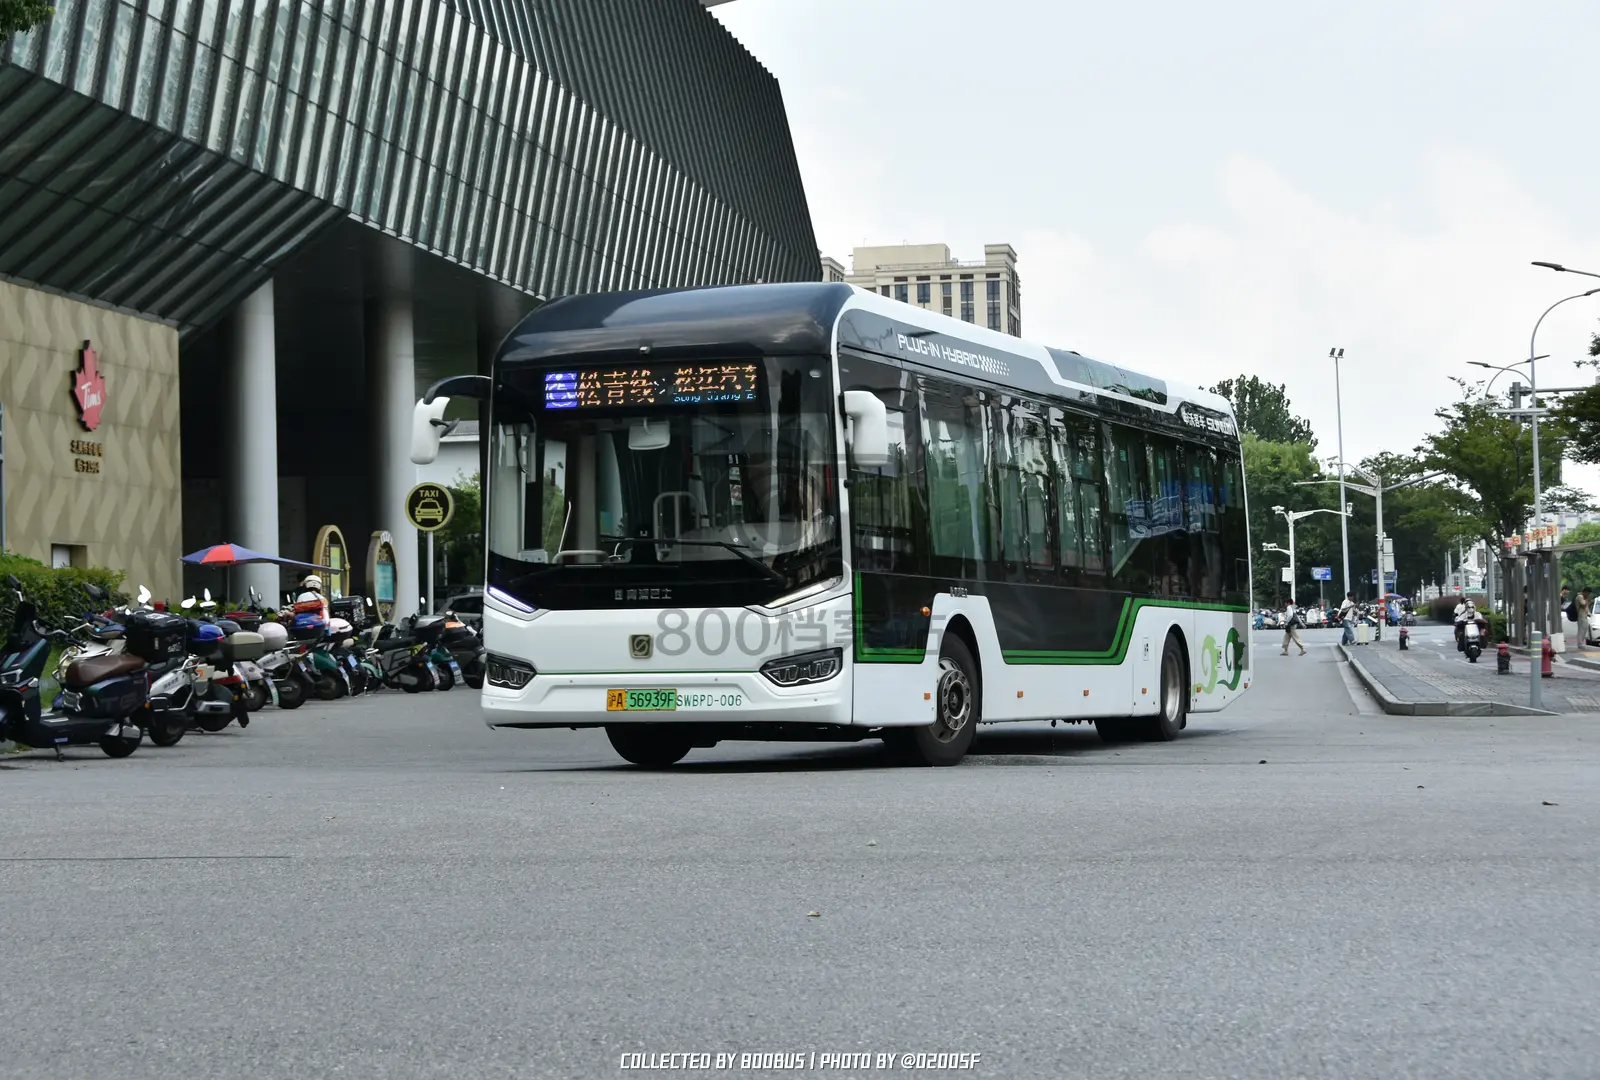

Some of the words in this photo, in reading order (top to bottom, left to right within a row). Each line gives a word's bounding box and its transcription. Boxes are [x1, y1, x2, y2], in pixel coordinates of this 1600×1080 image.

[897, 334, 941, 359] PLUG-IN
[941, 345, 981, 369] HYBRID
[81, 381, 101, 410] Tims
[419, 490, 439, 498] TAXI
[676, 694, 742, 707] SWBPD-006
